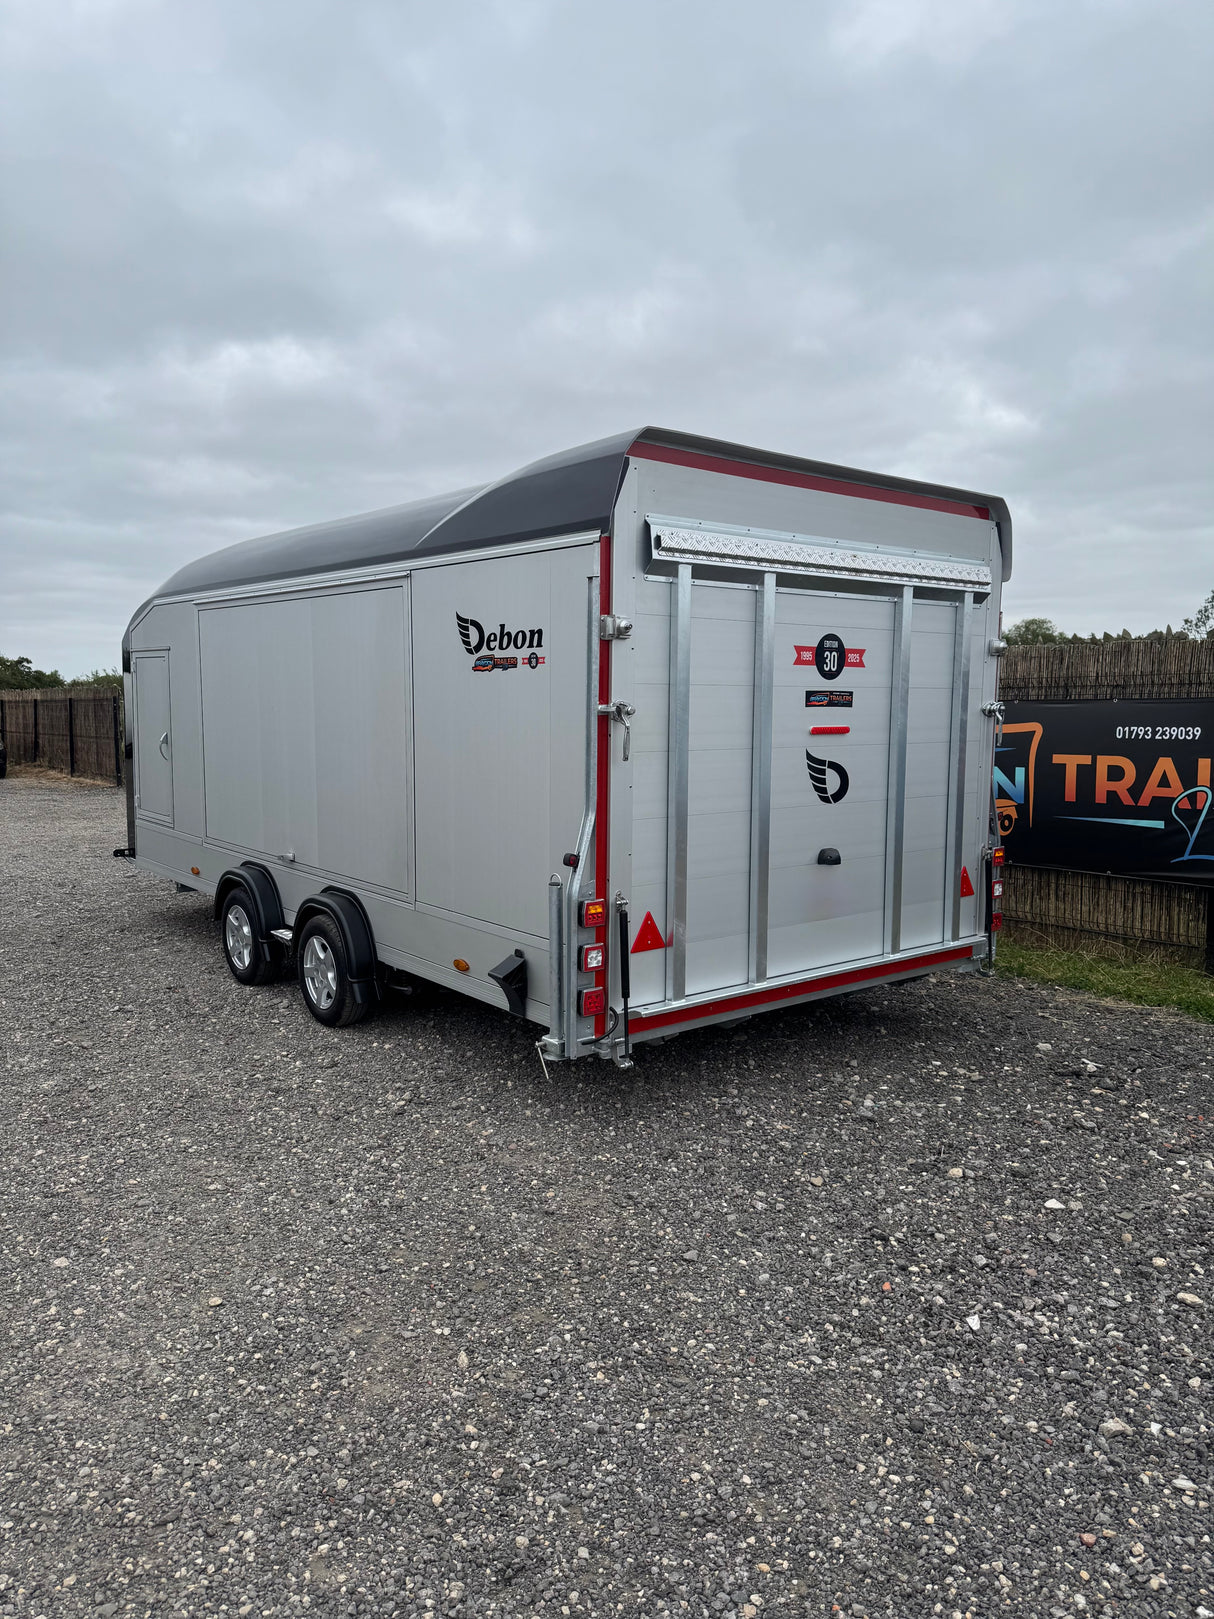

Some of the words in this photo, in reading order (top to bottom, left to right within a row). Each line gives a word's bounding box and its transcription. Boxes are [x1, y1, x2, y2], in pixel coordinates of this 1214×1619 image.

[455, 611, 543, 655] Debon
[494, 657, 517, 665] TRAILERS
[800, 651, 813, 660] 1995
[847, 653, 860, 663] 2025
[1116, 726, 1152, 740] 01793
[1155, 726, 1202, 740] 239039
[1052, 753, 1212, 811] TRAI
